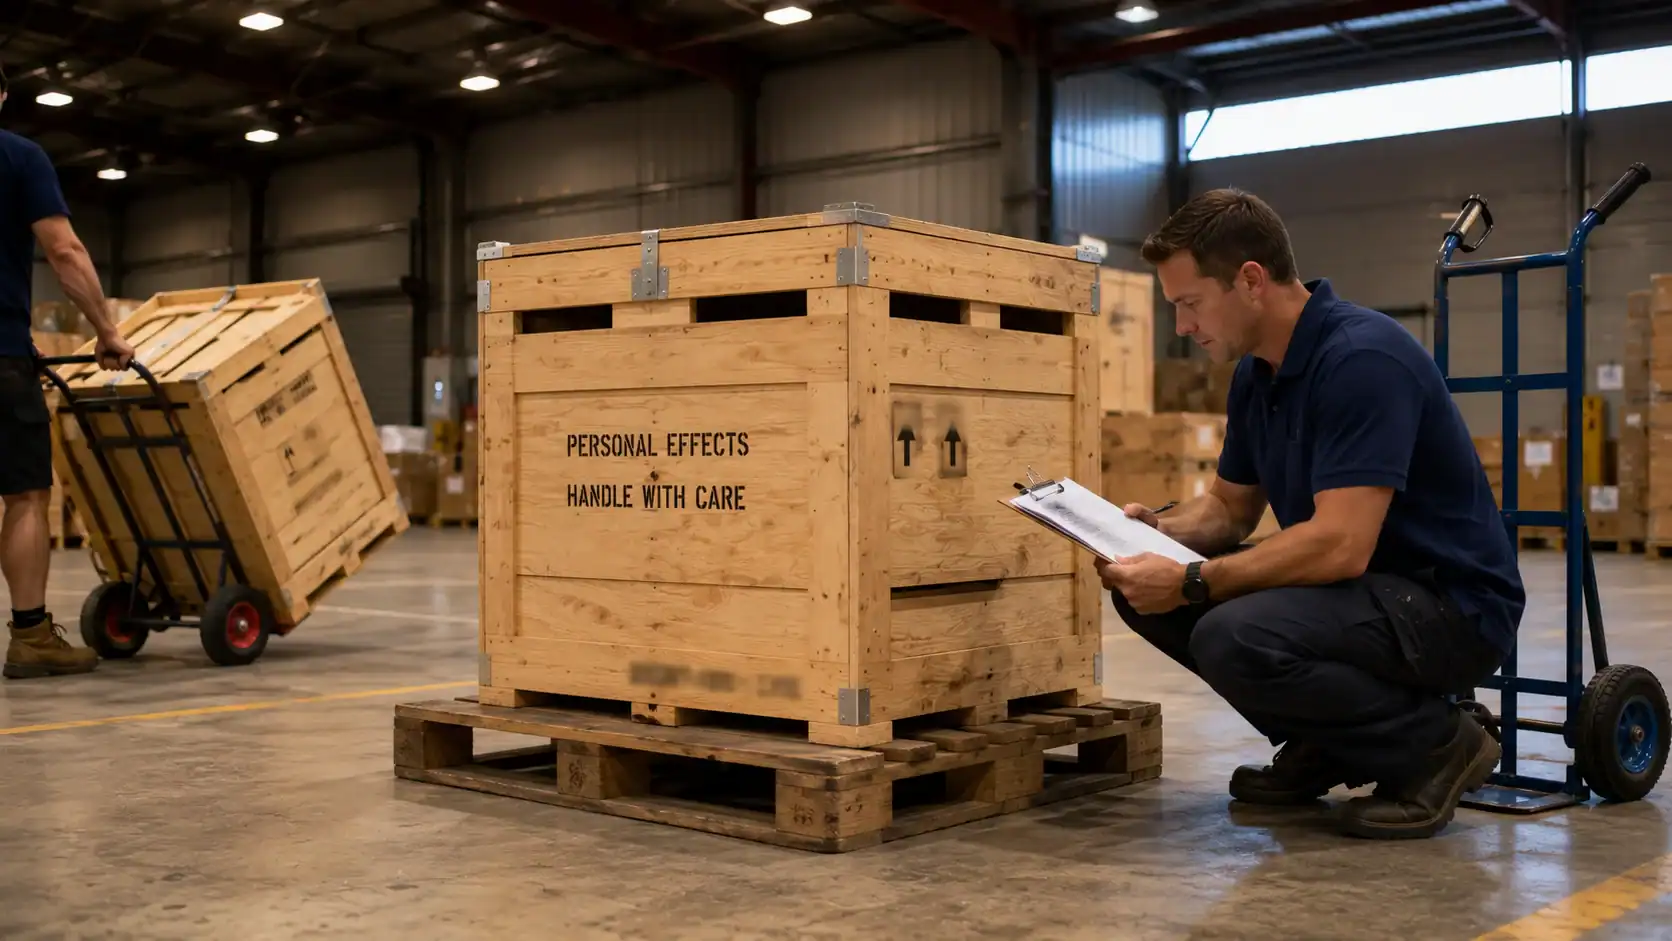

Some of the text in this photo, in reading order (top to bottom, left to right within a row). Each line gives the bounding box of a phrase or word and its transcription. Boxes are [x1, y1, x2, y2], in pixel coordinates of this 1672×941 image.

[567, 431, 749, 457] PERSONAL EFFECTS
[567, 484, 746, 510] HANDLE WITH CARE
